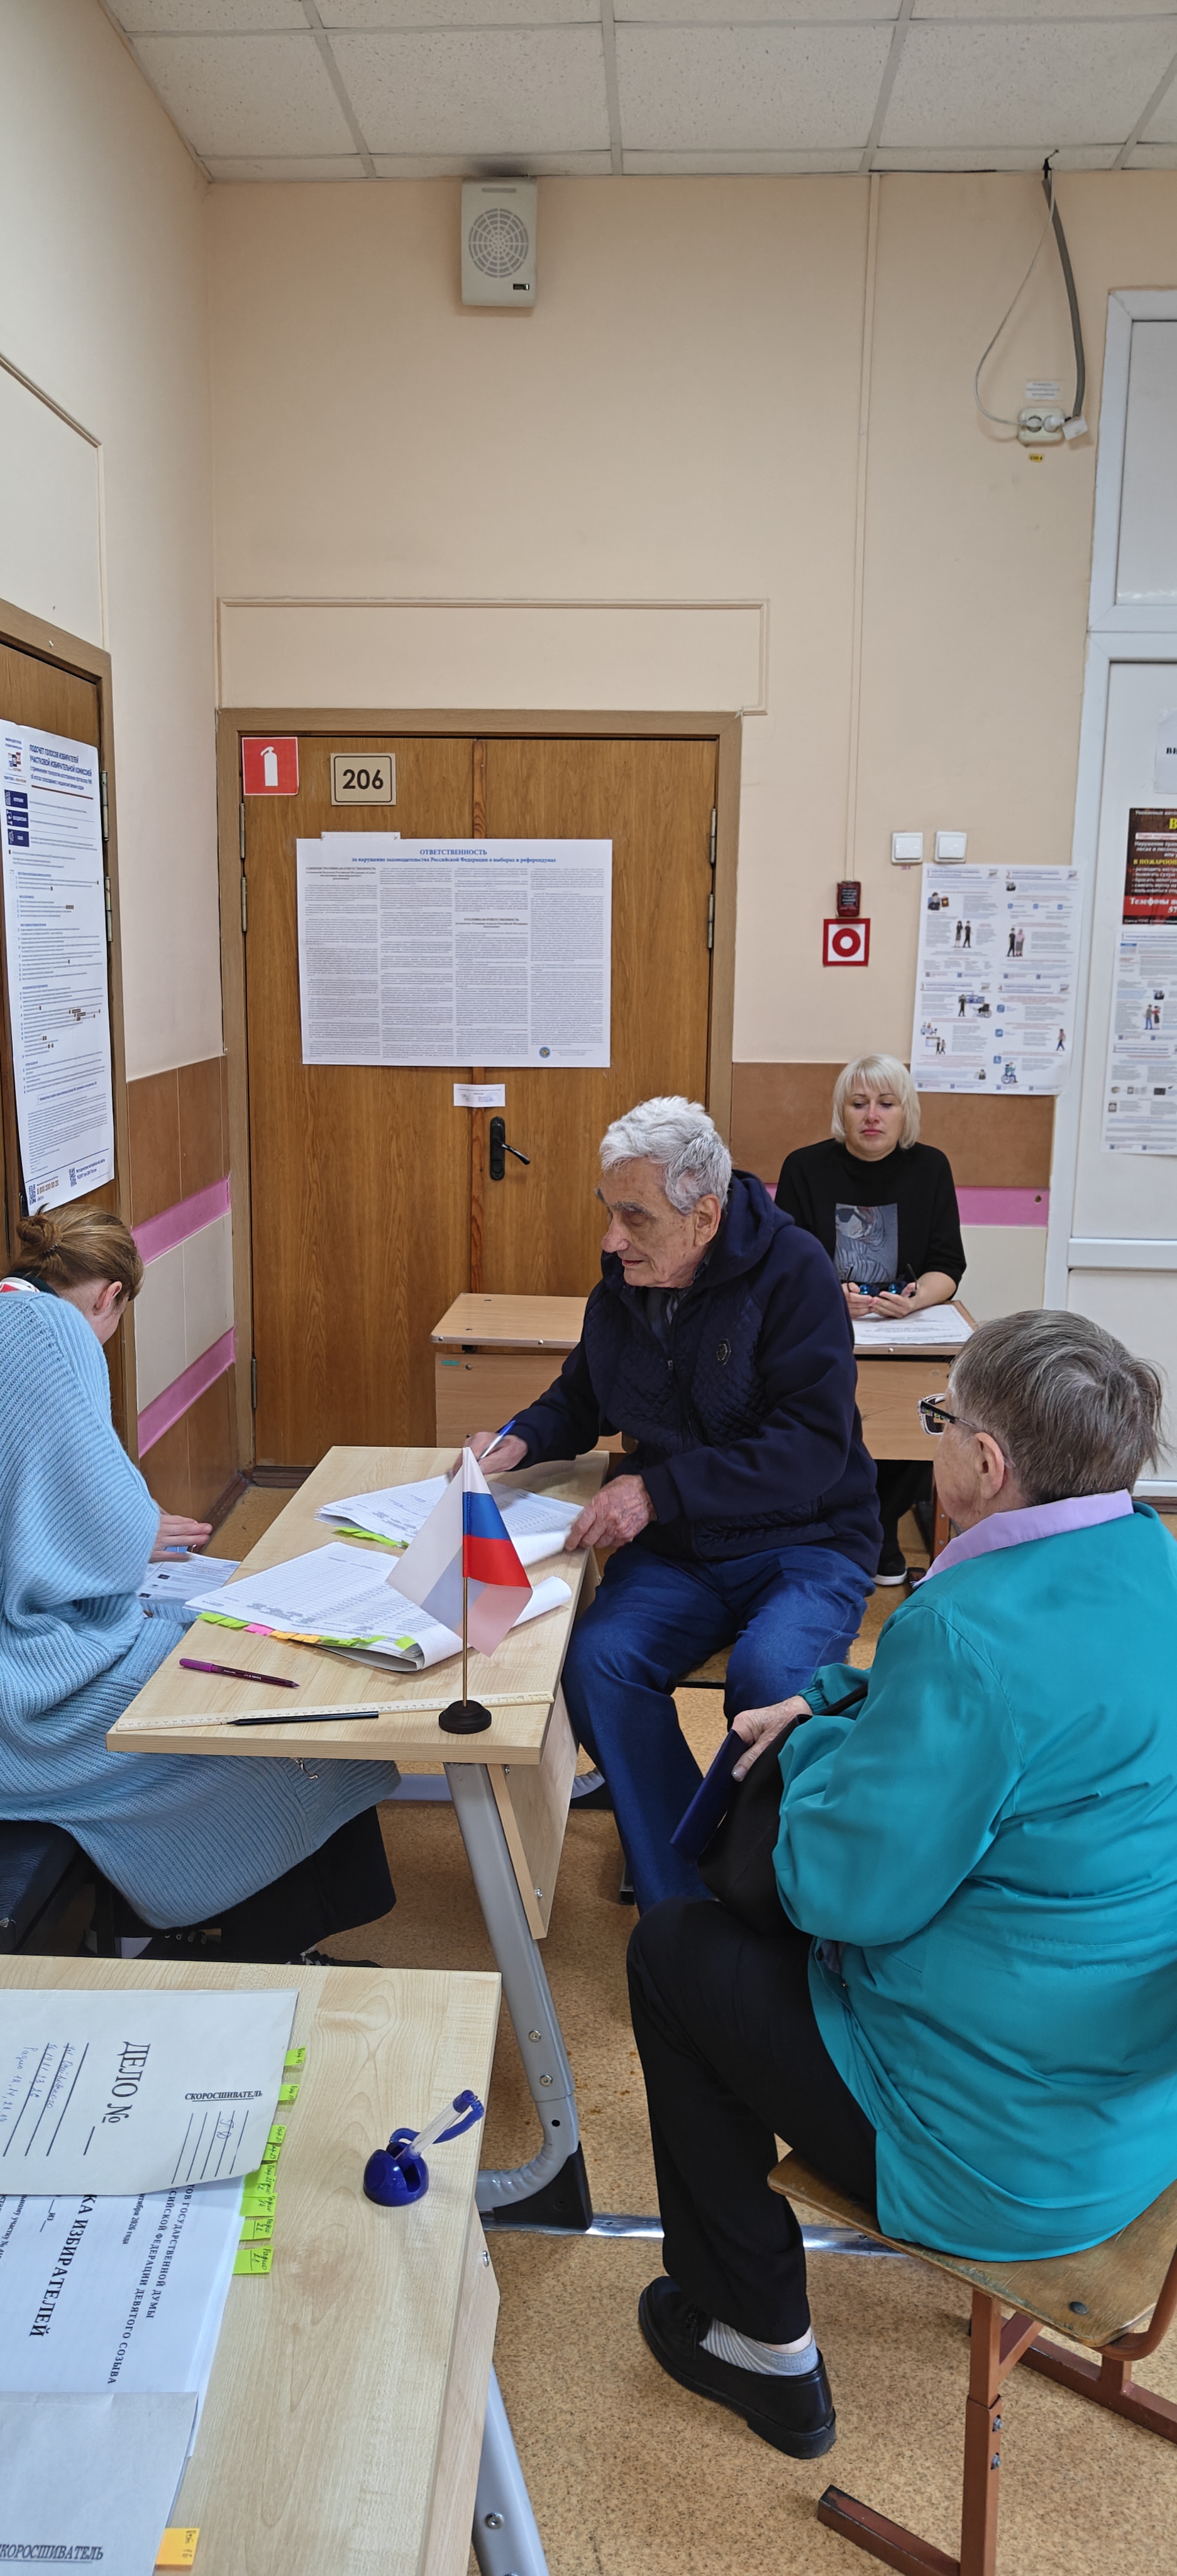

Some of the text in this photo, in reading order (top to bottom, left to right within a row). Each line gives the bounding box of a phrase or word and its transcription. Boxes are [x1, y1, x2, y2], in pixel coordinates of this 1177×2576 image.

[343, 769, 384, 789] 206
[1130, 897, 1169, 906] Телефоны
[16, 2046, 38, 2070] Радио
[102, 2041, 151, 2123] ДЕЛО №
[185, 2090, 263, 2100] СКОРОСШИВАТЕЛЬ
[47, 2212, 55, 2221] из
[128, 2217, 139, 2231] 2026
[1, 2217, 18, 2240] участку
[123, 2231, 132, 2245] года
[156, 2202, 189, 2287] ГОСУДАРСТВЕННОЙ
[262, 2248, 272, 2270] Радио
[29, 2219, 89, 2336] ИЗБИРАТЕЛЕЙ
[108, 2187, 178, 2384] СИЙСКОЙ ФЕДЕРАЦИИ ДЕВЯТОГО СОЗЫВА
[146, 2289, 162, 2319] ДУМЫ
[0, 2544, 103, 2560] КОРОСШИВАТЕЛЬ
